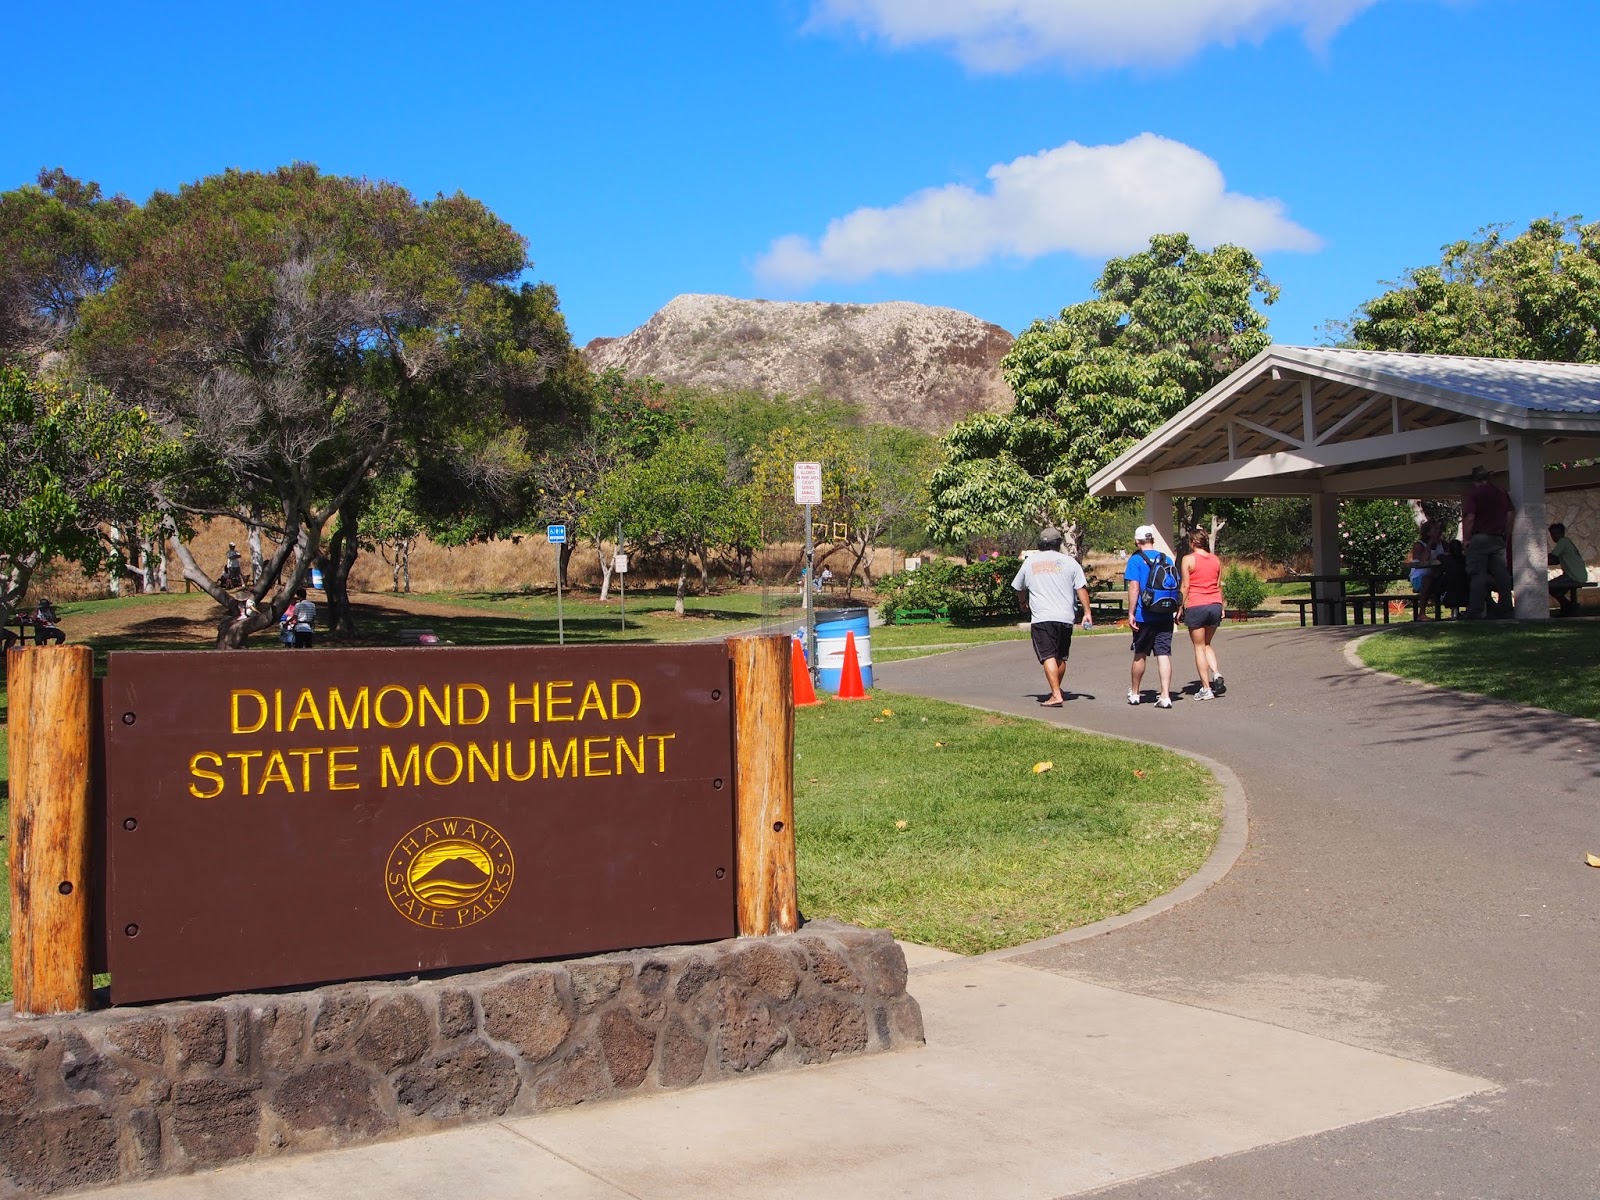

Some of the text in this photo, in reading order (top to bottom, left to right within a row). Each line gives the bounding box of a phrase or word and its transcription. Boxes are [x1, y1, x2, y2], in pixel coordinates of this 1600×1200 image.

[229, 678, 643, 736] DIAMOND HEAD
[187, 731, 677, 800] STATE MONUMENT
[389, 863, 511, 926] STATE PARKS
